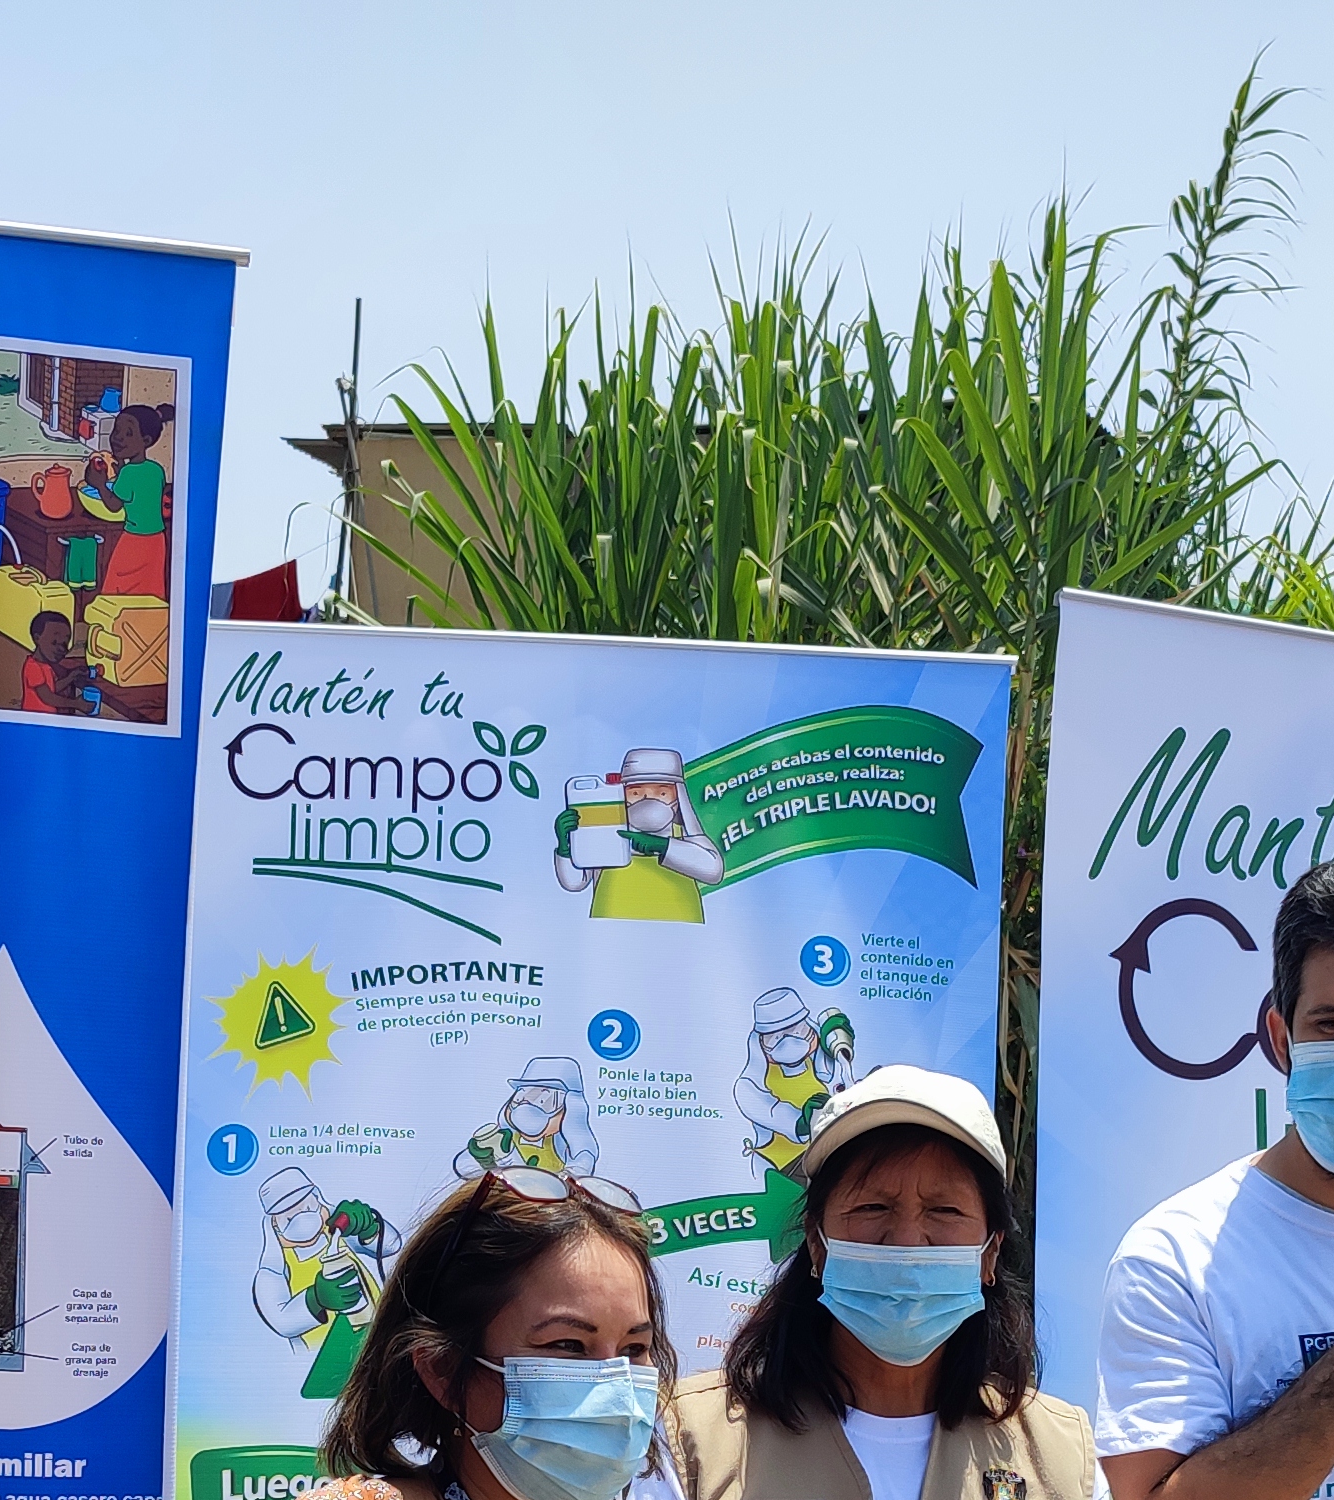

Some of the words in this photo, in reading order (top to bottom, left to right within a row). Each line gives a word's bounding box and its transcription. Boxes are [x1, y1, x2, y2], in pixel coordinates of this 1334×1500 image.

[212, 651, 394, 720] Mantén
[421, 671, 463, 719] tu
[223, 721, 506, 813] Campo
[705, 763, 778, 805] Apenas
[766, 747, 839, 775] acabas
[835, 744, 850, 759] el
[854, 745, 944, 766] contenido
[744, 780, 772, 805] del
[774, 772, 838, 792] envase,
[841, 764, 904, 782] realiza:
[719, 819, 756, 853] ¡EL
[753, 794, 831, 829] TRIPLE
[835, 789, 935, 816] LAVADO!
[290, 801, 491, 872] limpio
[860, 933, 904, 948] Vierte
[907, 936, 921, 949] el
[813, 945, 833, 974] 3
[861, 953, 933, 967] contenido
[940, 960, 953, 969] en
[351, 961, 544, 991] IMPORTANTE
[861, 967, 872, 980] el
[877, 969, 927, 986] tanque
[930, 972, 948, 985] de
[356, 996, 423, 1011] Siempre
[429, 993, 455, 1004] usa
[460, 991, 477, 1001] tu
[482, 992, 541, 1008] equipo
[860, 985, 931, 1002] aplicación
[358, 1018, 377, 1032] de
[381, 1010, 465, 1032] protección
[471, 1013, 541, 1028] personal
[430, 1030, 468, 1047] (EPP)
[601, 1019, 622, 1048] 2
[599, 1067, 639, 1081] Ponle
[644, 1069, 655, 1081] la
[660, 1071, 692, 1086] tapa
[598, 1087, 606, 1099] y
[610, 1086, 660, 1101] agítalo
[665, 1087, 696, 1100] bien
[598, 1105, 623, 1116] por
[626, 1104, 644, 1116] 30
[648, 1105, 723, 1120] segundos.
[270, 1125, 307, 1137] Llena
[313, 1125, 333, 1137] 1/4
[337, 1123, 359, 1136] del
[364, 1127, 415, 1139] envase
[223, 1134, 236, 1163] 1
[269, 1146, 293, 1155] con
[298, 1144, 331, 1157] agua
[337, 1141, 381, 1156] limpia
[647, 1217, 668, 1246] 3
[671, 1207, 756, 1240] VECES
[687, 1267, 723, 1288] Así
